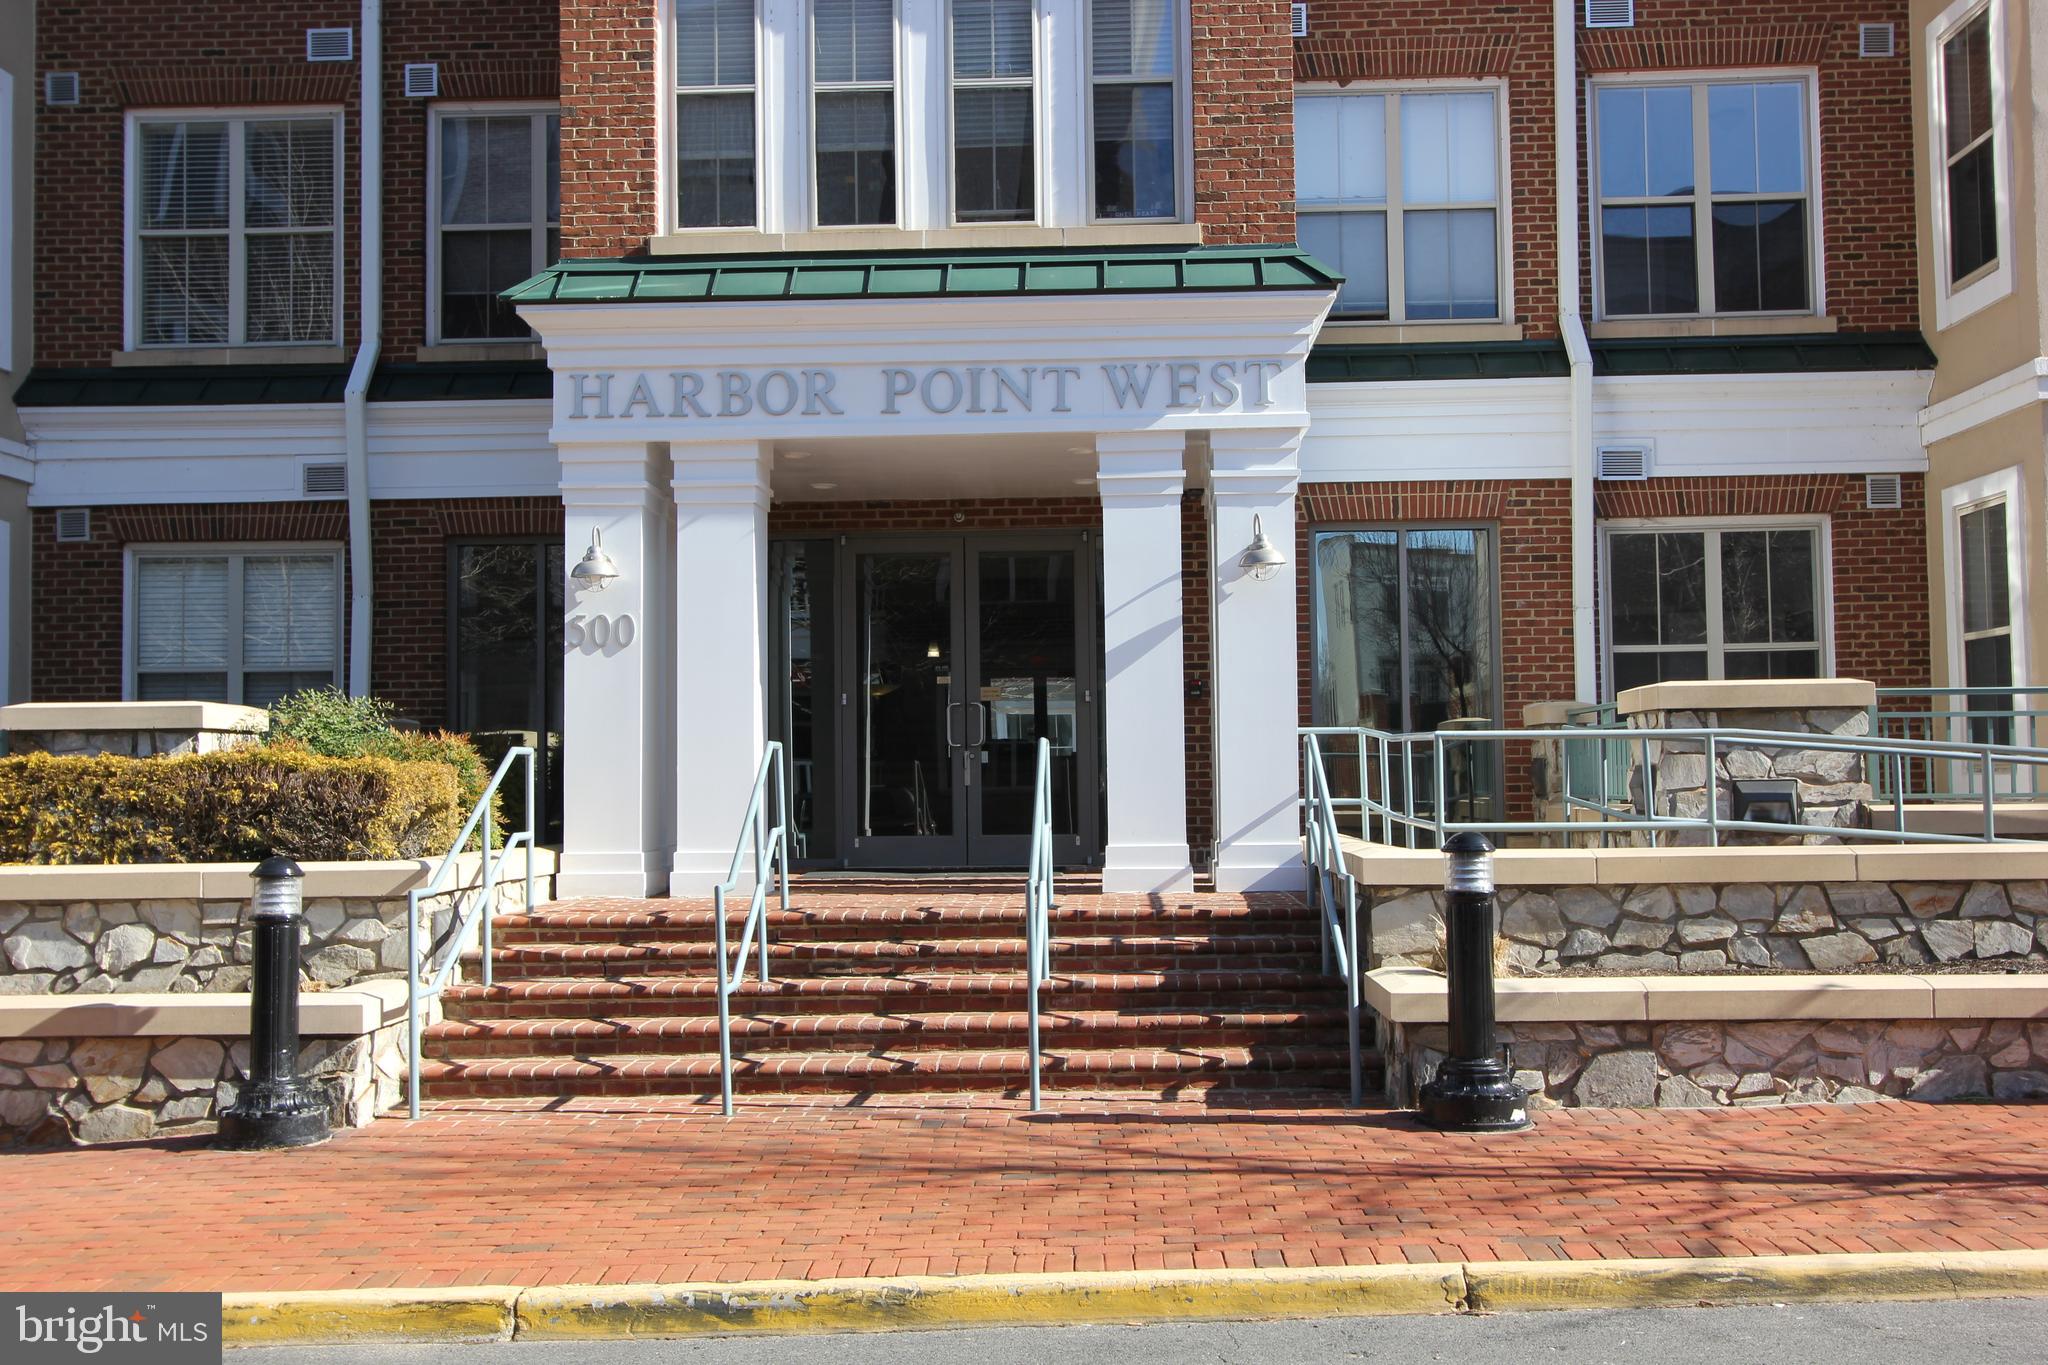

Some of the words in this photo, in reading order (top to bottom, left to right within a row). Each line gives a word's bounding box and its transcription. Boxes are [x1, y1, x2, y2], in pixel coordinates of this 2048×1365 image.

[568, 369, 845, 419] HARBOR
[880, 366, 1081, 414] POINT
[1099, 360, 1283, 409] WEST
[565, 613, 635, 649] 500
